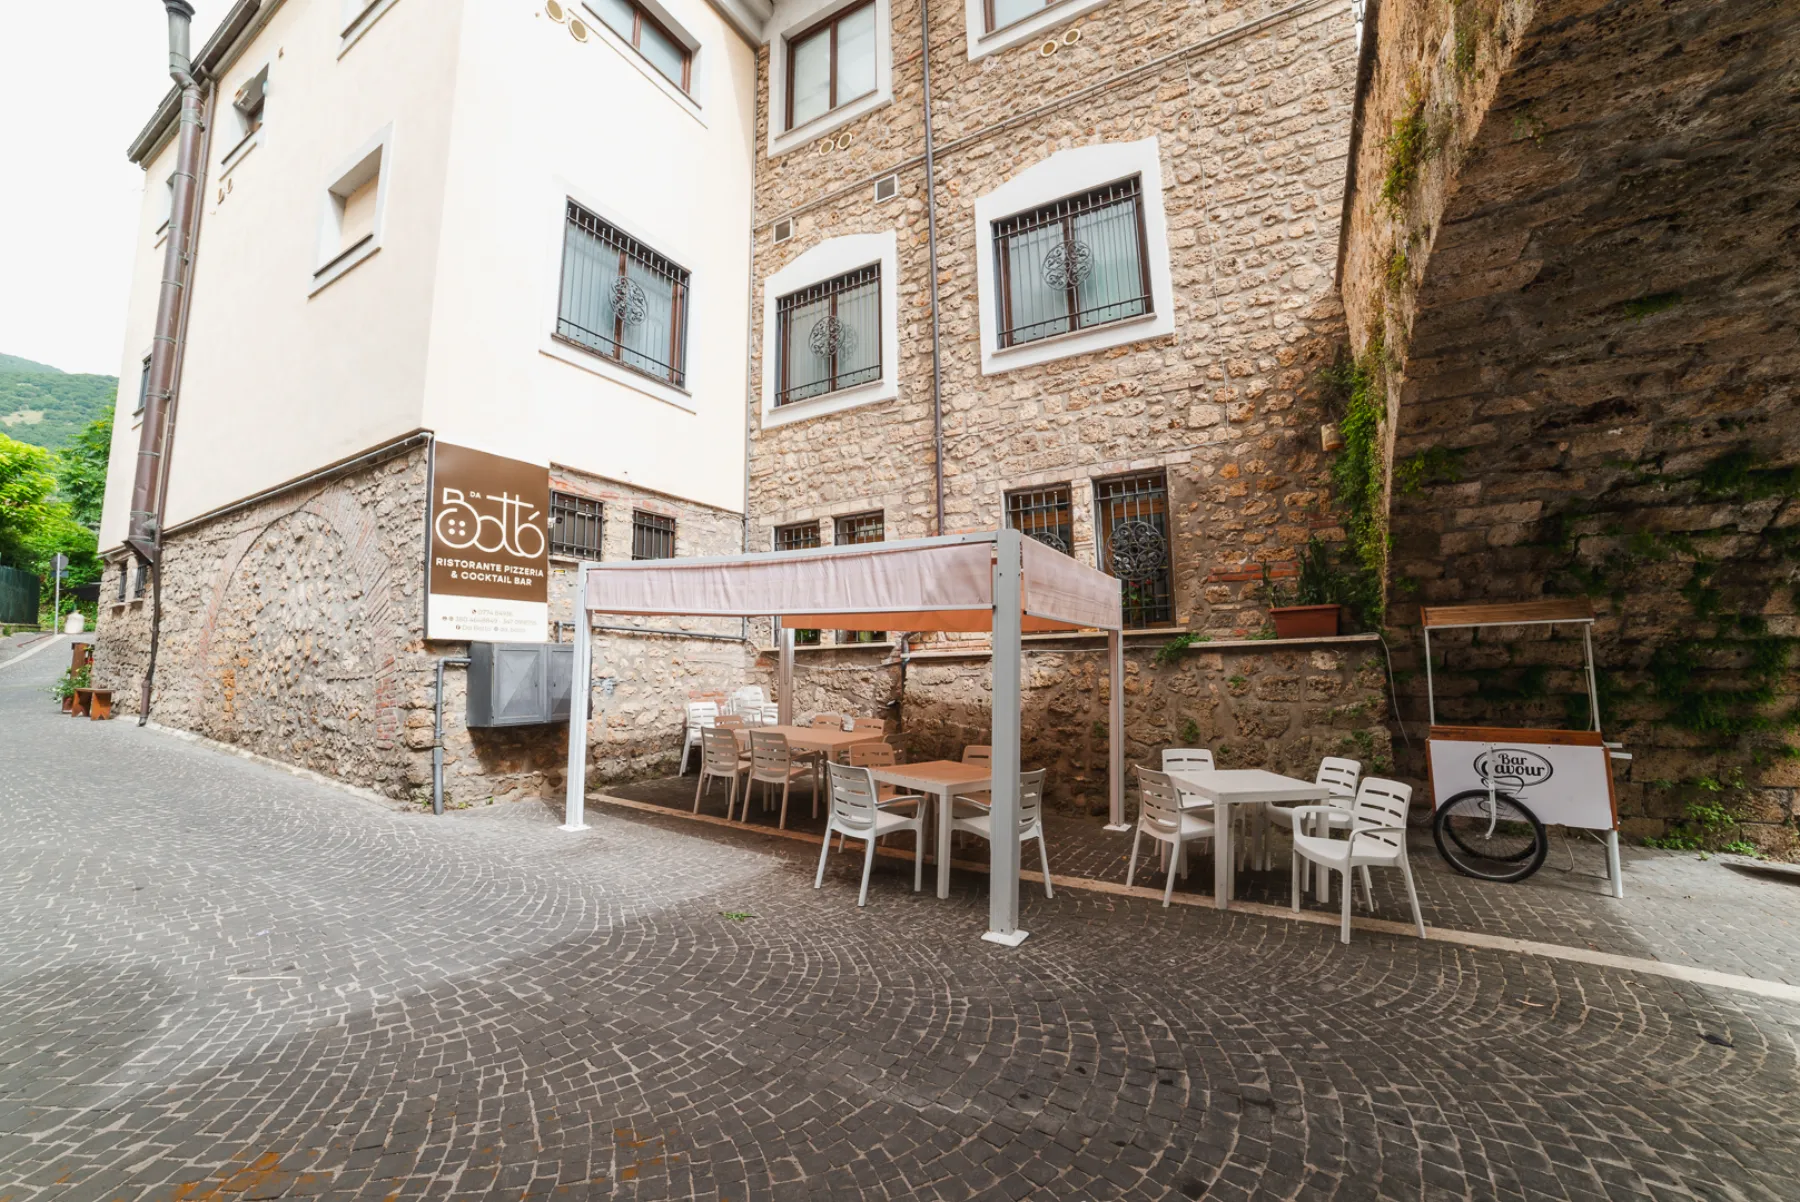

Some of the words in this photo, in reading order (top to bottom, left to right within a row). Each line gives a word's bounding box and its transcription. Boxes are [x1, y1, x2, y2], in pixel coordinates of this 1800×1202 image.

[470, 491, 482, 499] DA
[436, 558, 502, 572] RISTORANTE
[504, 565, 544, 577] PIZZERIA
[451, 570, 458, 578] &
[461, 572, 512, 584] COCKTAIL
[514, 577, 532, 586] BAR
[1498, 753, 1527, 765] Bar
